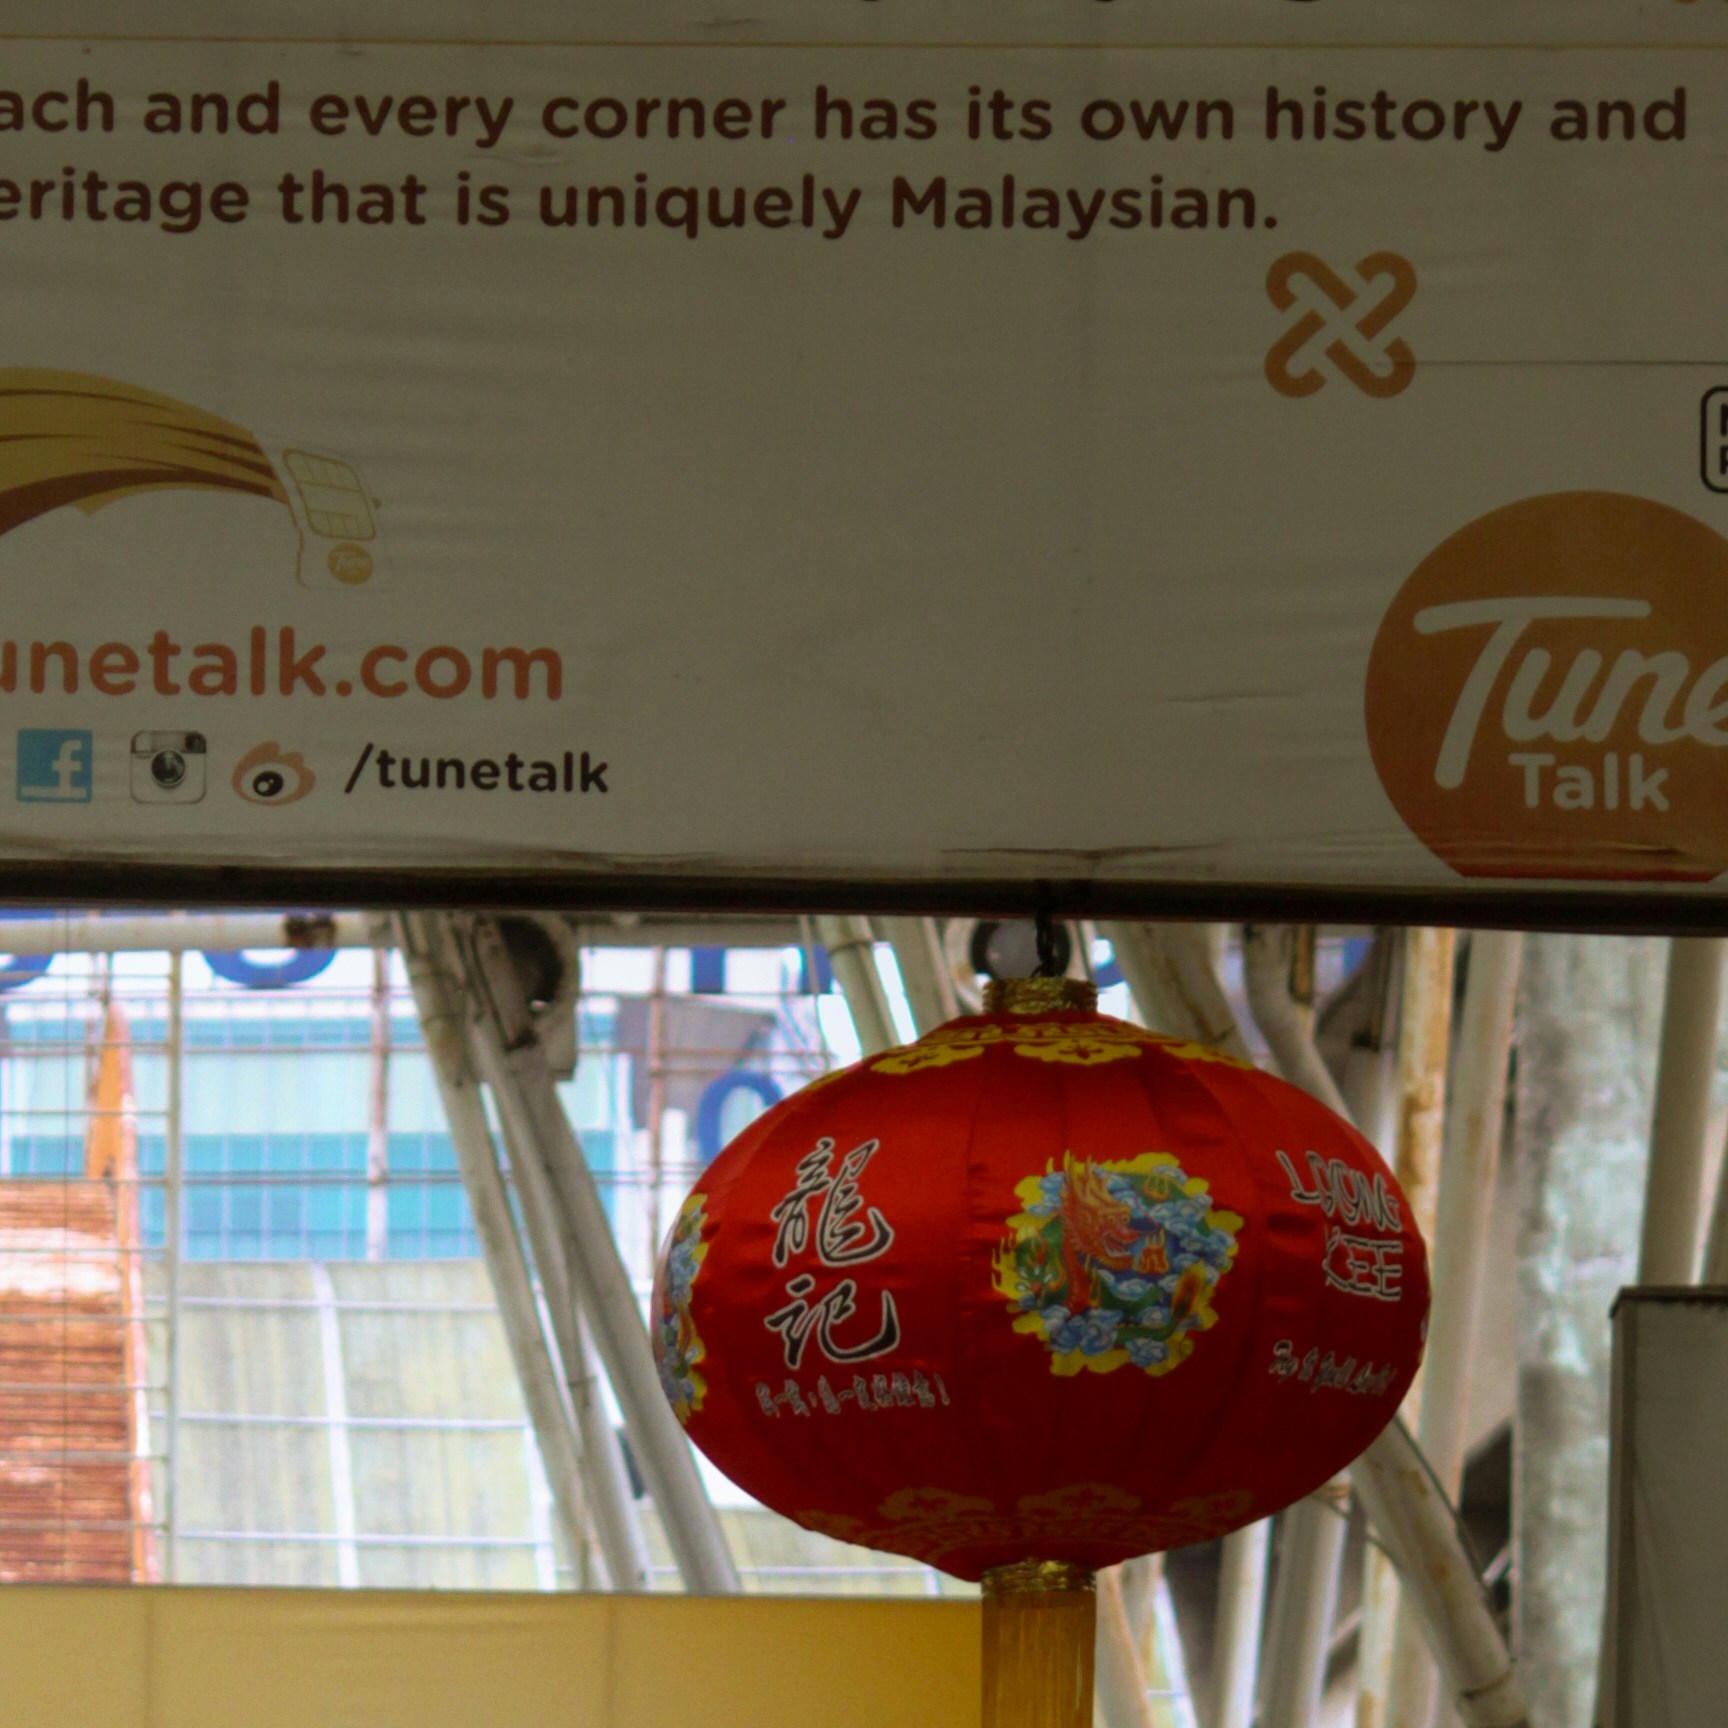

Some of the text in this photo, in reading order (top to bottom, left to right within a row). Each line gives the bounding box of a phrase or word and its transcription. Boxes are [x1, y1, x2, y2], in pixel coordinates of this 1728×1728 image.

[143, 80, 281, 135] and
[309, 92, 514, 148] every
[542, 94, 787, 140] corner
[813, 86, 938, 141] has
[967, 86, 1053, 141] its
[1080, 98, 1235, 141] own
[1264, 86, 1523, 152] history
[1549, 87, 1687, 142] and
[278, 169, 428, 225] that
[457, 171, 512, 226] is
[539, 173, 863, 240] uniquely
[891, 175, 1279, 240] Malaysian.
[1413, 596, 1728, 790] Tune
[343, 742, 610, 795] /tunetalk
[1507, 751, 1670, 812] Talk
[763, 1136, 902, 1369] 龍記
[1322, 1223, 1404, 1302] KEE
